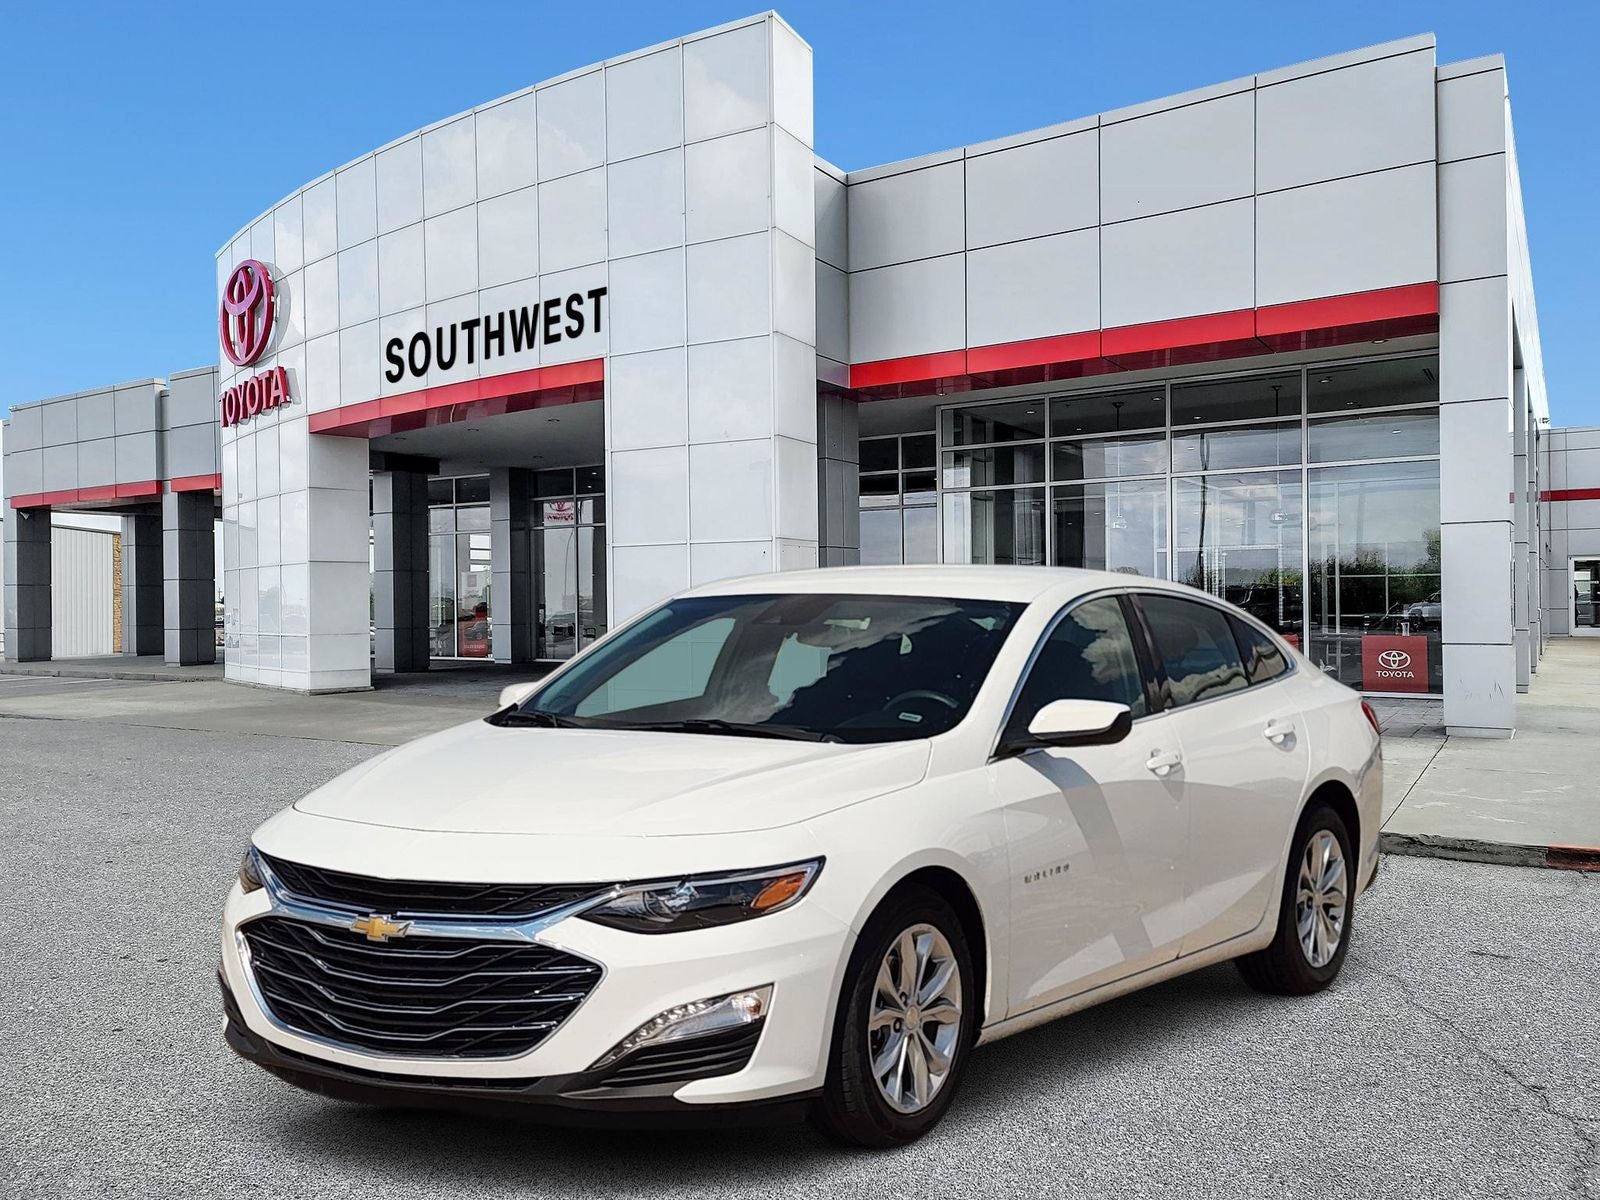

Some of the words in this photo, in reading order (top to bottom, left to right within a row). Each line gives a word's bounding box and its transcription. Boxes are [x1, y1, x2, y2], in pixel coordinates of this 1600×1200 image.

[385, 287, 608, 384] SOUTHWEST
[219, 366, 292, 428] TOYOTA
[1376, 670, 1415, 678] TOYOTA
